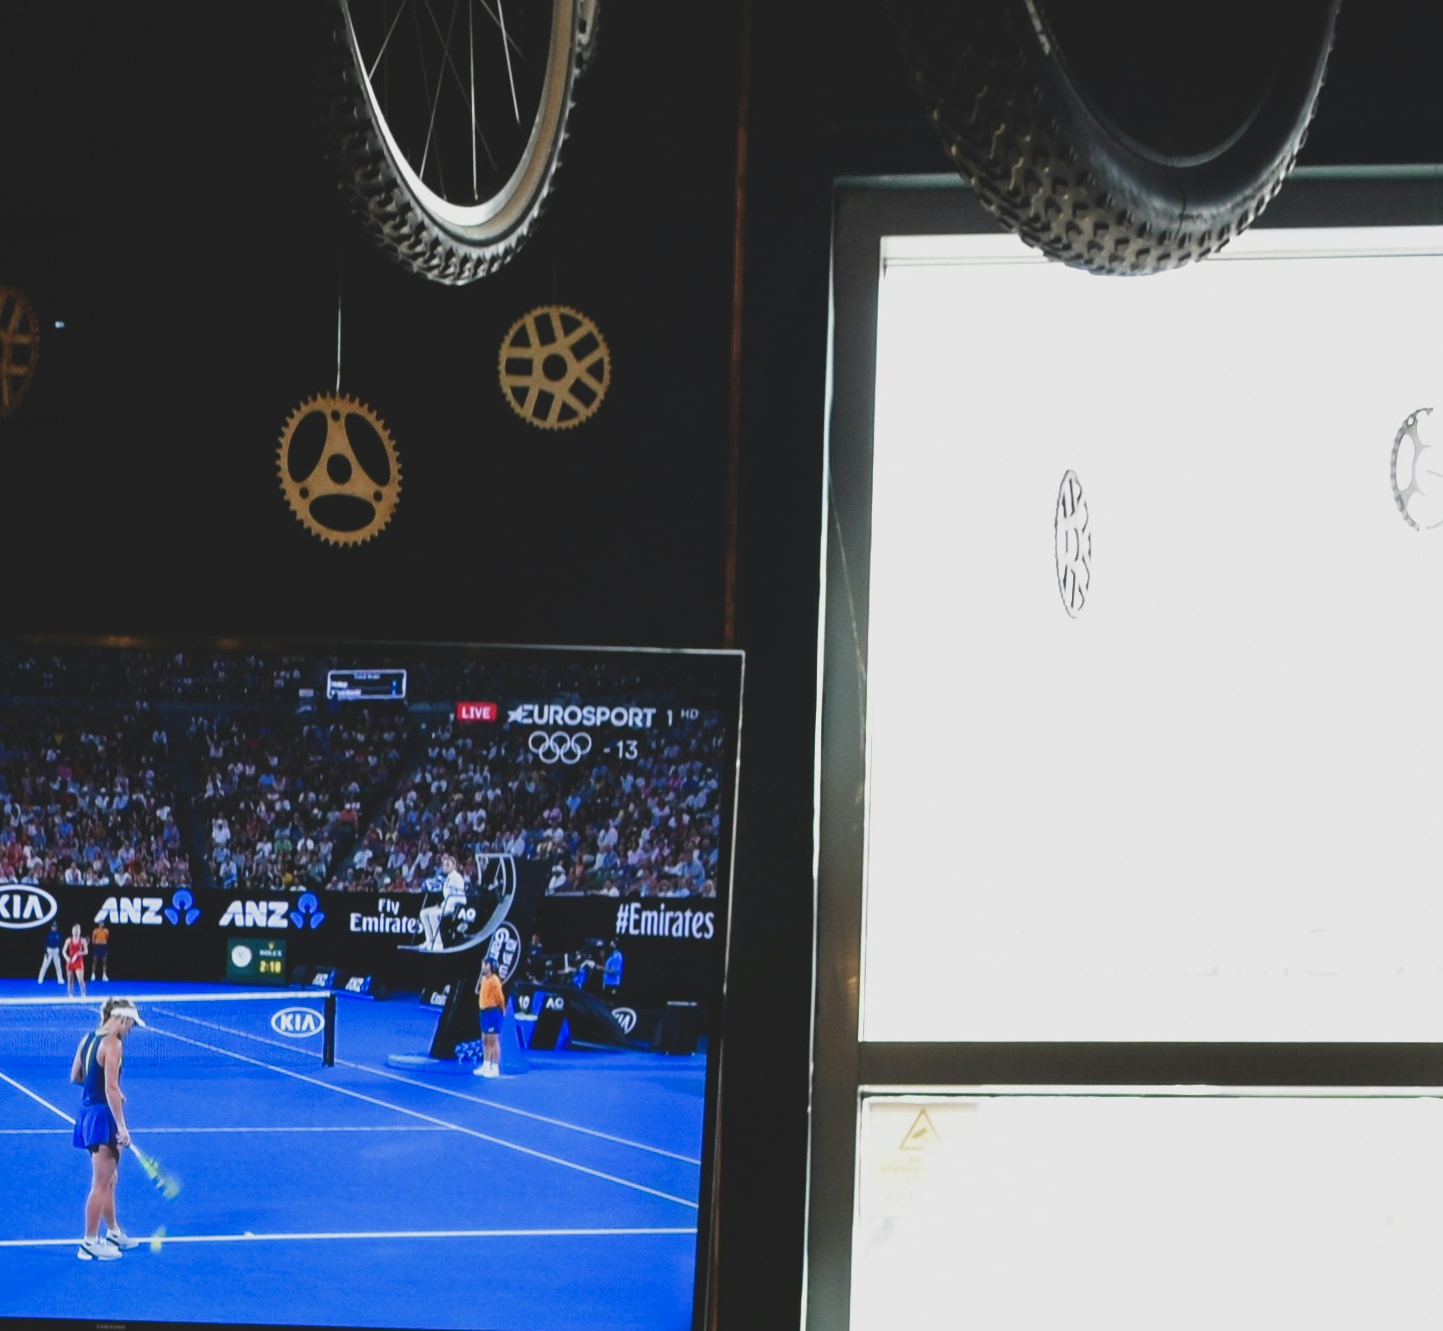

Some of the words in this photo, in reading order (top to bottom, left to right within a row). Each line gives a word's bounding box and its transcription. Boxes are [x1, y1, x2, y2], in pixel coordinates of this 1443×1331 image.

[461, 705, 491, 720] LIVE
[519, 704, 656, 728] EUROSPORT
[667, 709, 674, 726] 1
[617, 740, 639, 759] 13
[94, 897, 163, 925] ANZ
[219, 900, 289, 928] ANZ
[377, 898, 400, 916] Fly
[350, 912, 424, 934] Emirates
[616, 902, 715, 940] #Emirates
[280, 1013, 316, 1032] KIA
